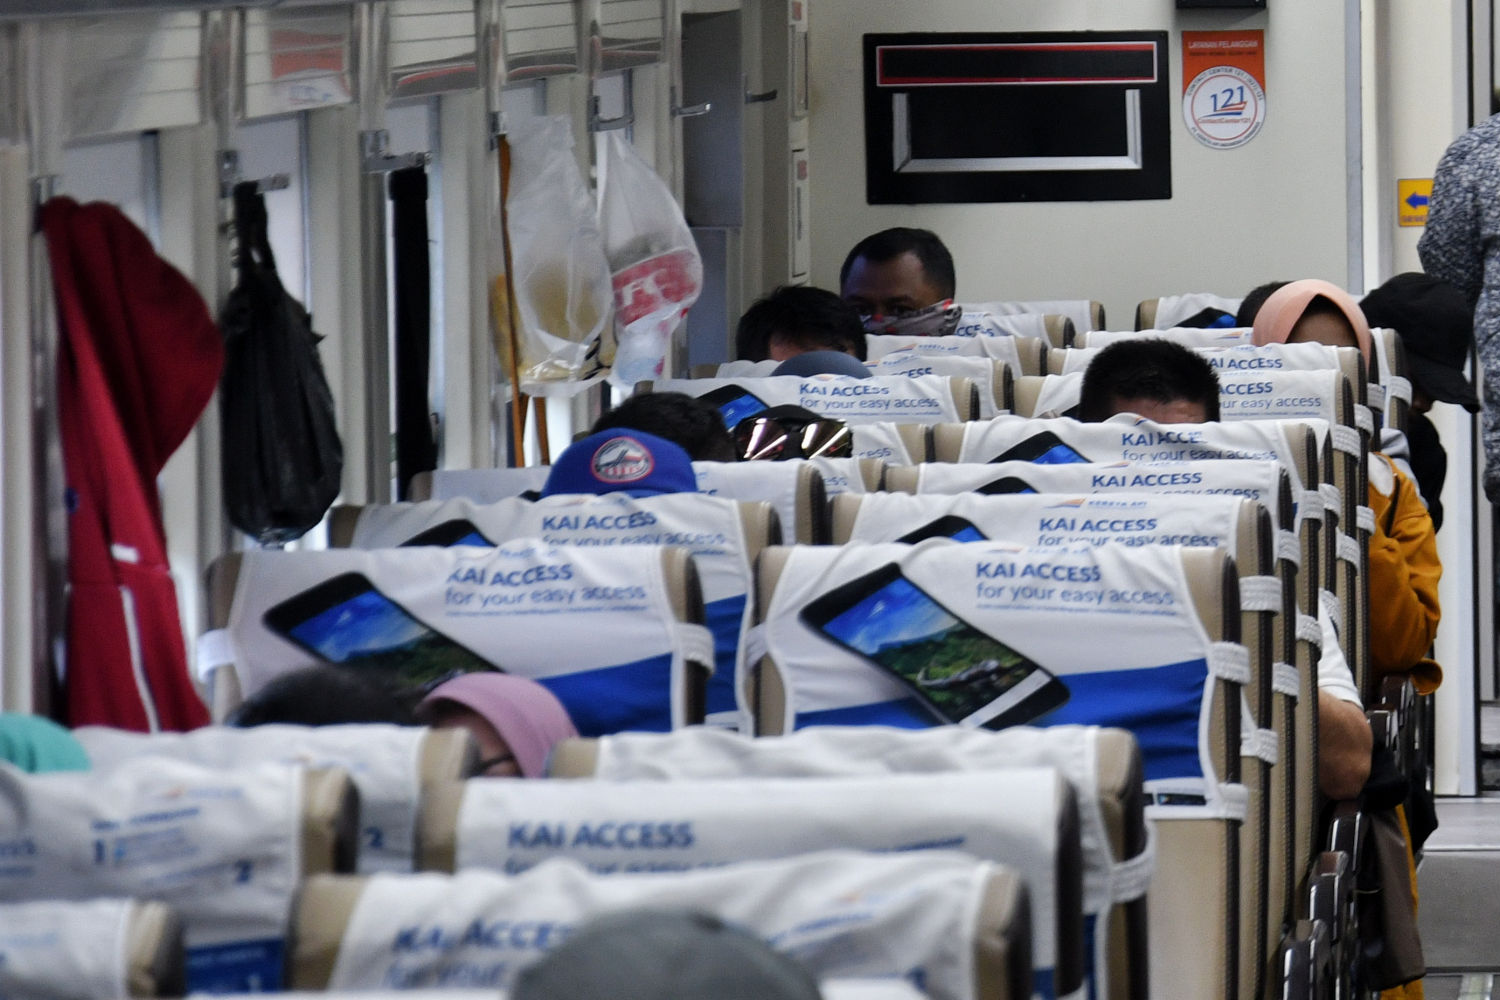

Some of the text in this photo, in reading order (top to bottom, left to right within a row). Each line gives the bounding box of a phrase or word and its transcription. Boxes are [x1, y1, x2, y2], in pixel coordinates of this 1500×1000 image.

[1211, 86, 1244, 113] 121
[1228, 358, 1283, 369] ACCESS
[800, 383, 890, 397] KAI ACCESS
[824, 400, 859, 410] your
[860, 399, 890, 410] easy
[894, 398, 939, 408] access
[1243, 400, 1272, 409] easy
[1276, 397, 1321, 407] access
[1122, 433, 1153, 446] KAI
[1123, 449, 1140, 461] for
[1151, 450, 1183, 461] your
[1092, 473, 1203, 487] KAI ACCESS
[543, 510, 657, 531] KAI ACCESS
[1039, 517, 1158, 532] KAI ACCESS
[1038, 534, 1063, 546] for
[1160, 534, 1220, 547] access
[490, 563, 574, 587] ACCESS
[976, 562, 1102, 583] KAI ACCESS
[480, 591, 526, 608] your
[581, 585, 646, 600] access
[976, 582, 1175, 606] for your easy access
[365, 826, 383, 848] 2
[508, 821, 695, 849] KAI ACCESS
